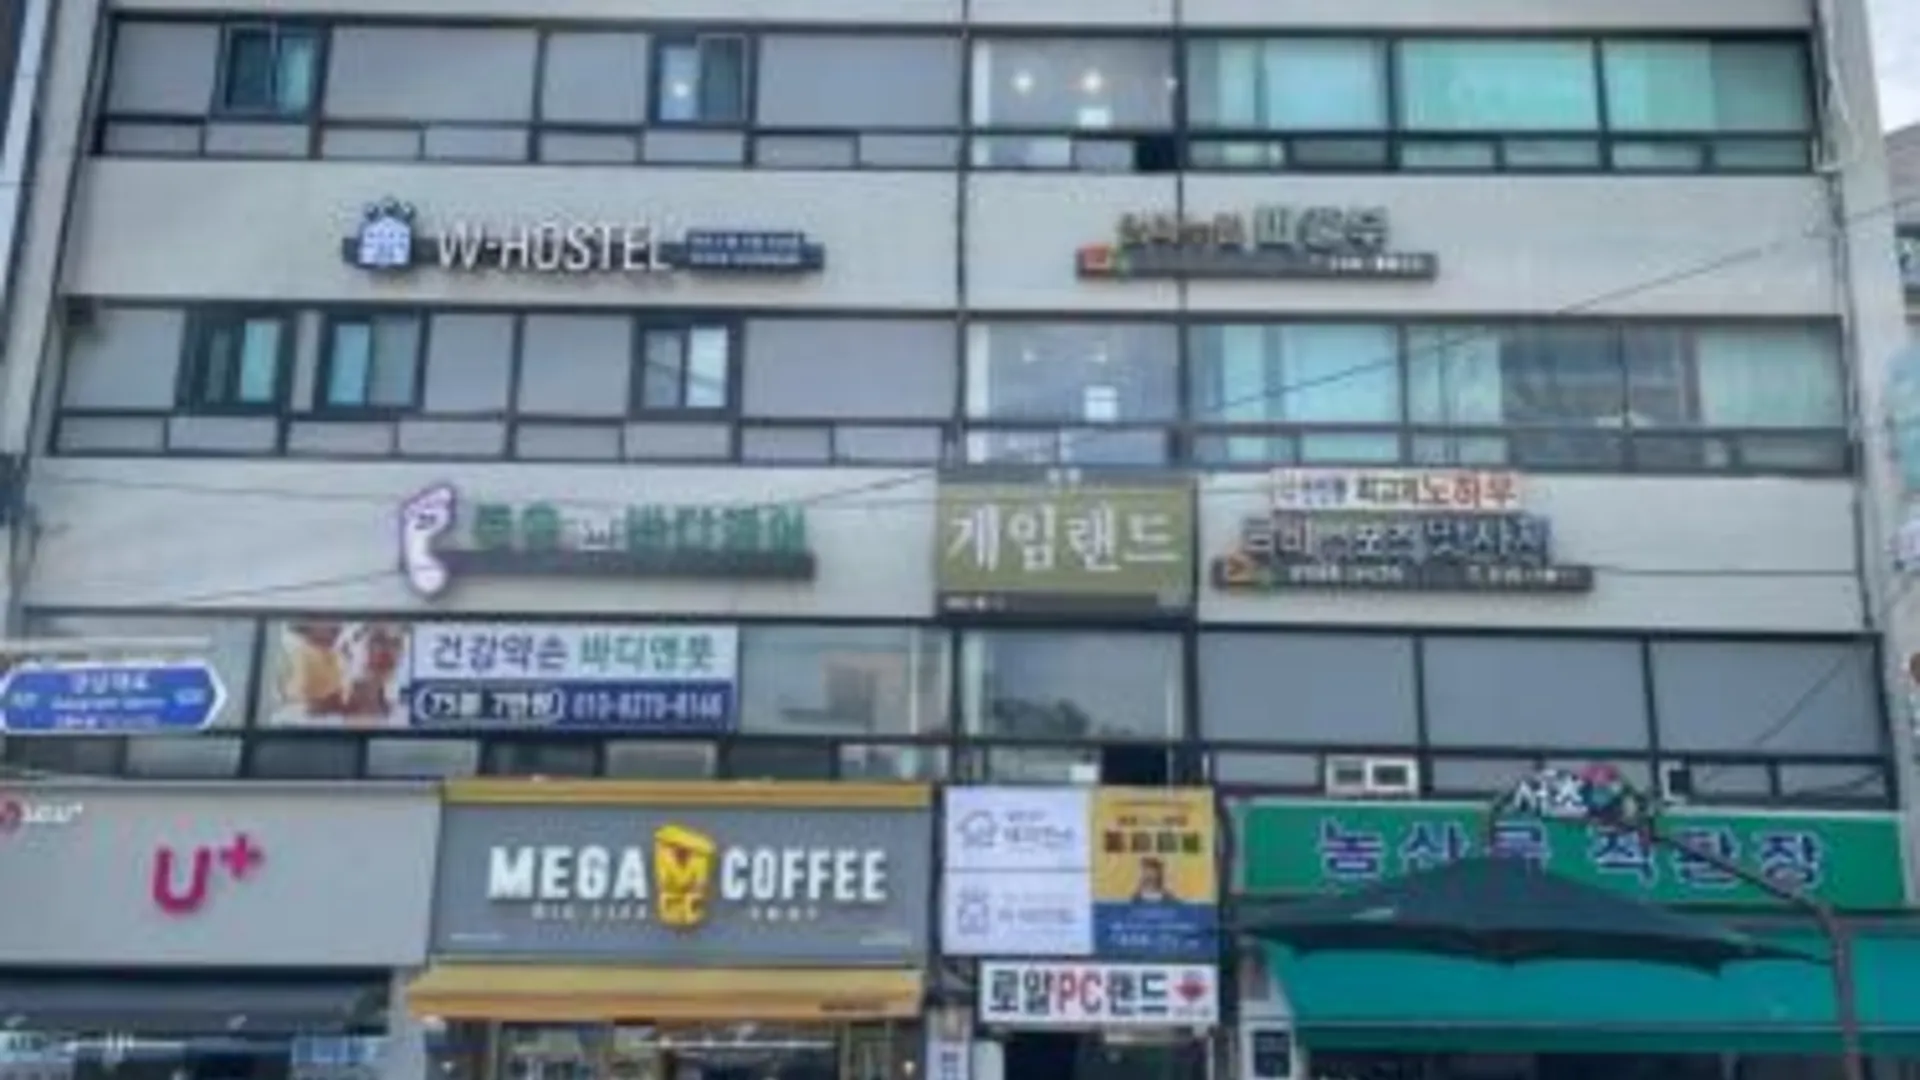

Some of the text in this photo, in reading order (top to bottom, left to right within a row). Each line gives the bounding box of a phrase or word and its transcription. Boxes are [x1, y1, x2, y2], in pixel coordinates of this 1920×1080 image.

[949, 502, 1182, 572] 게임랜드
[430, 634, 568, 671] 건강약손
[152, 833, 264, 915] U+
[488, 845, 886, 902] MEGA COFFEE
